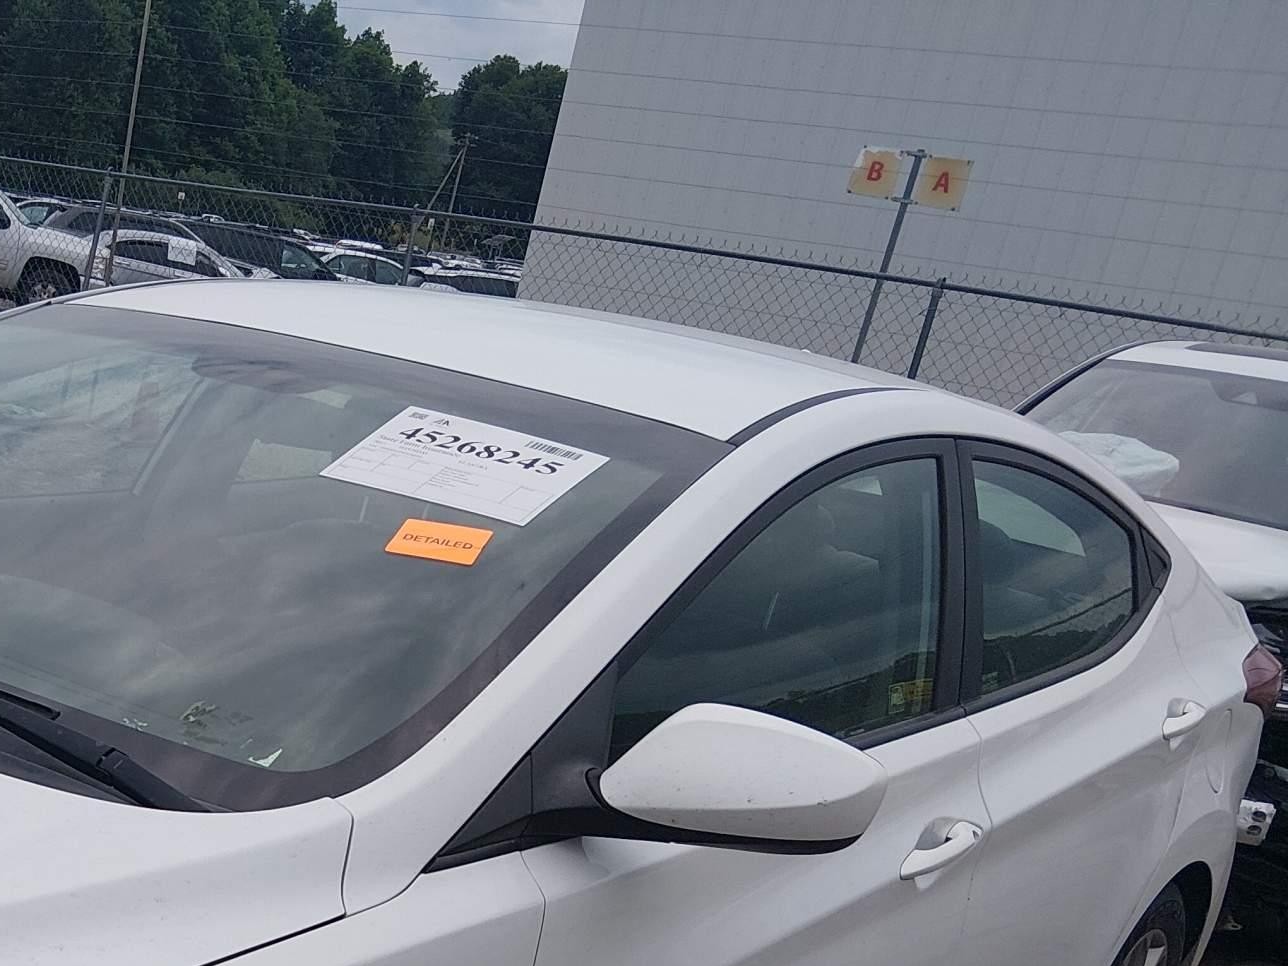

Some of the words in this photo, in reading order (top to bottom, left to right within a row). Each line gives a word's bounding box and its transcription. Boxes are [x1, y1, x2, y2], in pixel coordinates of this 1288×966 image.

[867, 161, 884, 181] B
[932, 172, 950, 193] A
[399, 427, 564, 475] 45268245
[402, 532, 473, 550] DETAILED
